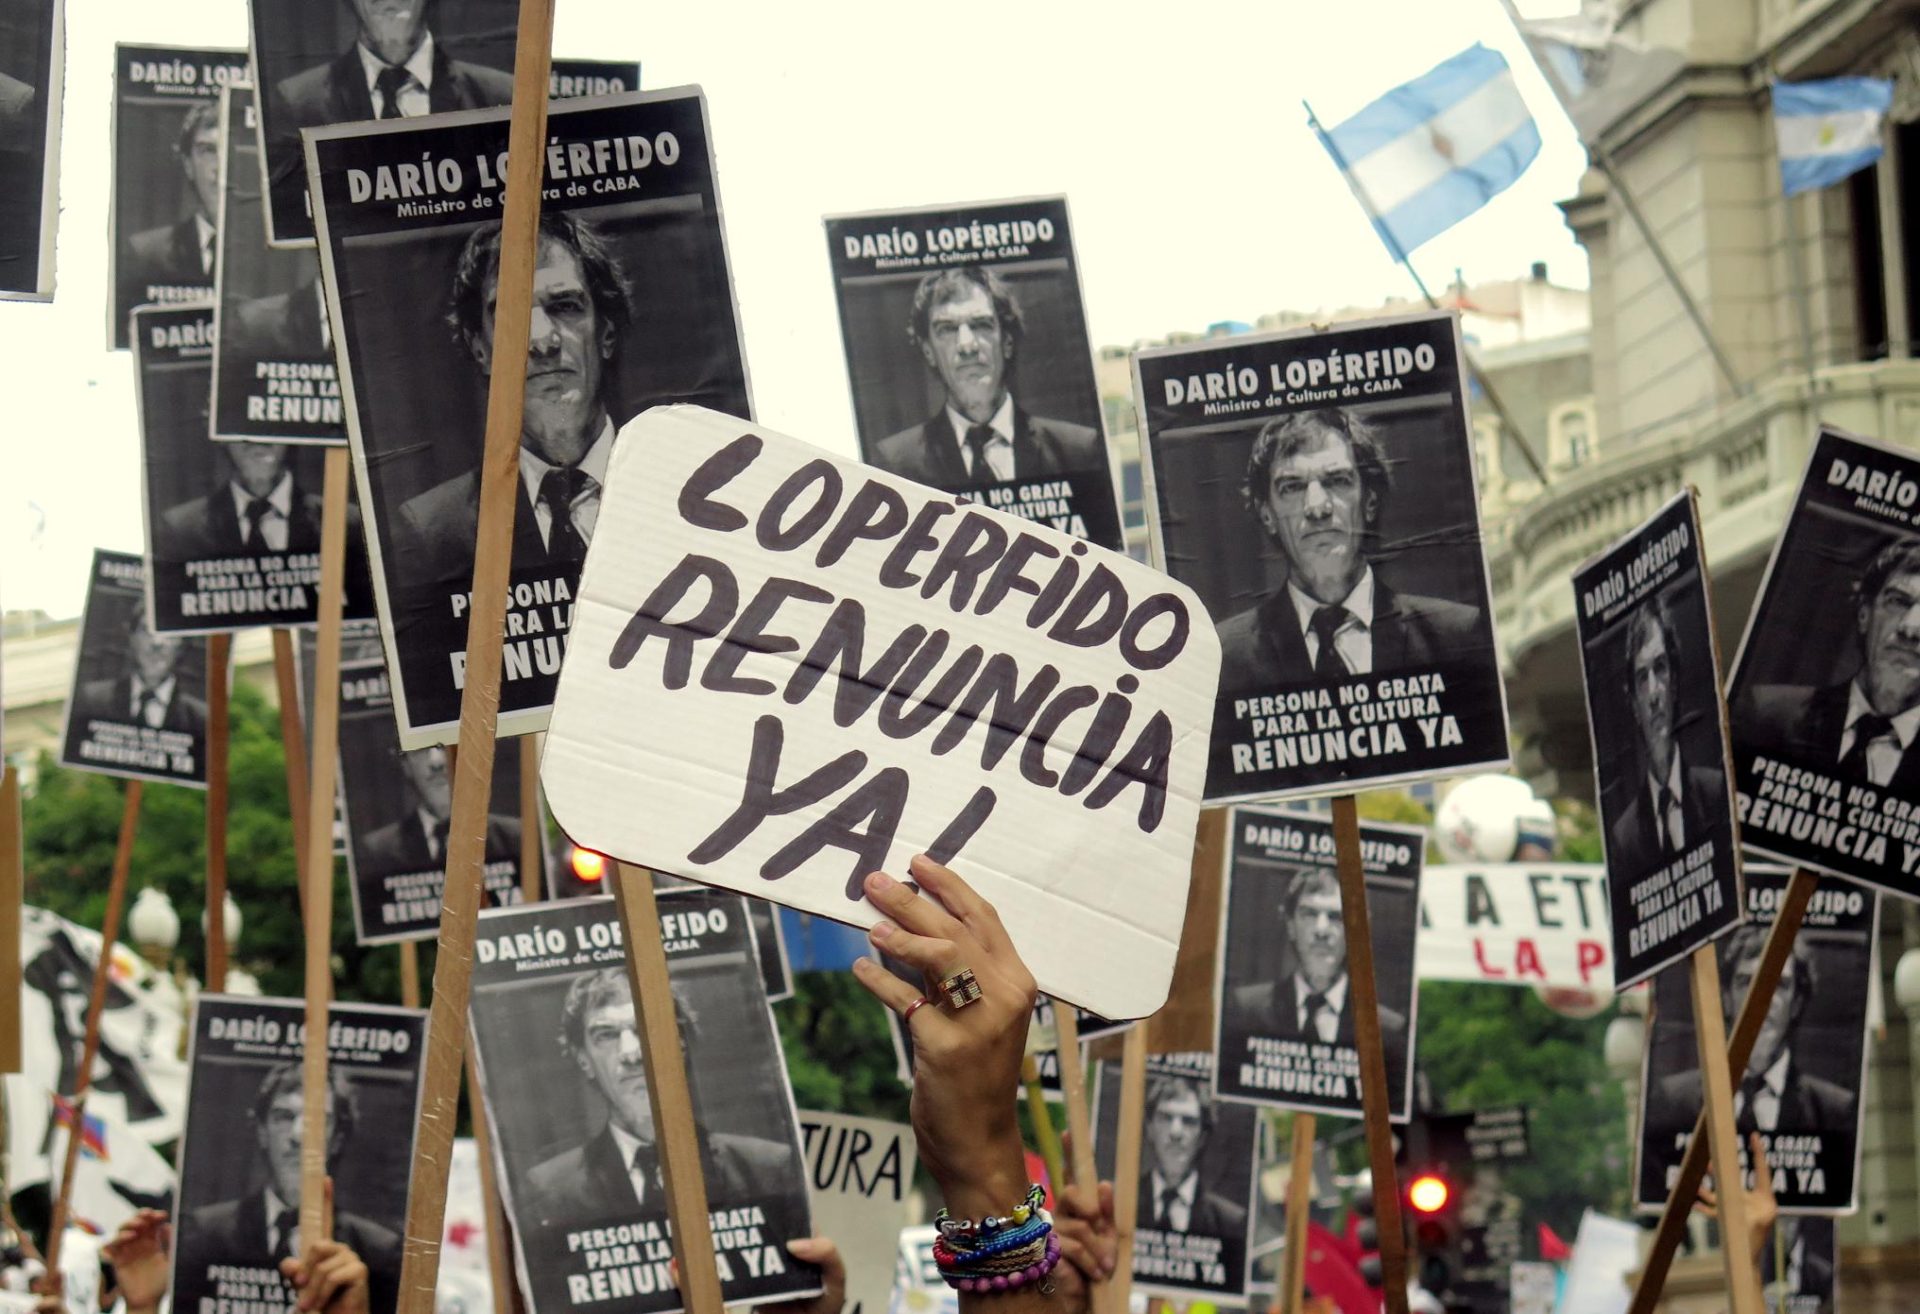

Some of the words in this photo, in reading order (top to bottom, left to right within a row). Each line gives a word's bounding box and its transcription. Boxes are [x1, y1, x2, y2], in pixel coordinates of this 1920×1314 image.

[129, 58, 197, 84] DARÍO
[347, 152, 463, 203] DARÍO
[476, 132, 680, 189] LÉRFIDO
[397, 200, 466, 218] Ministro
[472, 192, 493, 209] de
[566, 181, 588, 198] de
[593, 175, 641, 194] CABA
[844, 227, 918, 259] DARÍO
[926, 218, 1054, 253] LOPÉRFIDO
[875, 256, 921, 269] Ministro
[922, 253, 938, 265] de
[939, 250, 980, 264] Cultura
[982, 247, 997, 259] de
[256, 362, 335, 381] PERSONA
[267, 379, 315, 397] PARA
[319, 380, 340, 397] LA
[1164, 363, 1259, 406] DARÍO
[1270, 343, 1436, 391] LOPÉRFIDO
[248, 395, 341, 424] RENUN
[1204, 398, 1260, 417] Ministro
[1265, 394, 1283, 408] de
[1286, 387, 1338, 405] Cultura
[1342, 383, 1360, 397] de
[1364, 378, 1403, 394] CABA
[989, 487, 1015, 505] NO
[1019, 480, 1074, 499] GRATA
[1826, 458, 1918, 507] DARÍO
[1051, 514, 1089, 539] YA
[1854, 496, 1909, 522] Ministro
[185, 557, 258, 577] PERSONA
[260, 555, 285, 571] NO
[197, 573, 240, 591] PARA
[242, 572, 263, 588] LA
[1584, 569, 1625, 618] DARÍO
[1626, 522, 1689, 588] LOPÉRFIDO
[180, 585, 308, 617] RENUNCIA
[450, 577, 571, 618] PSONA
[503, 609, 544, 638] RA
[449, 634, 569, 690] RNU
[608, 553, 1173, 834] RENUNCIA
[1234, 688, 1333, 719] PERSONA
[1339, 683, 1370, 705] NO
[1377, 673, 1446, 698] GRATA
[1252, 713, 1310, 739] PARA
[1316, 711, 1343, 730] LA
[1349, 695, 1442, 724] CULTURA
[1231, 722, 1407, 774] RENUNCIA
[1417, 715, 1464, 749] YA
[1751, 756, 1842, 800] PERSONA
[1847, 785, 1878, 809] NO
[1758, 779, 1812, 811] PARA
[1816, 797, 1842, 821] LA
[1848, 806, 1920, 845] CULTUR
[1245, 824, 1304, 851] DARÍO
[1735, 791, 1888, 867] RENUNCIA
[1901, 843, 1920, 879] Y
[1465, 874, 1501, 927] A
[1527, 874, 1611, 929] ET
[1629, 893, 1701, 958] RENUNCIA
[1703, 879, 1723, 915] YA
[476, 926, 566, 963] DARÍO
[575, 908, 728, 950] LOPFIDO
[516, 956, 570, 972] Ministro
[573, 953, 592, 965] de
[664, 938, 700, 953] CABA
[1473, 937, 1547, 980] LA
[209, 1015, 281, 1043] DARÍO
[286, 1020, 410, 1053] LÉRFIDO
[1240, 1063, 1348, 1099] RENUNCIA
[1796, 1167, 1826, 1195] YA
[567, 1221, 661, 1252] PERSONA
[585, 1246, 643, 1270] PARA
[646, 1239, 672, 1260] LA
[207, 1264, 280, 1285] PERSONA
[217, 1281, 260, 1299] PARA
[263, 1284, 285, 1302] LA
[567, 1252, 735, 1304] RENUNA
[740, 1245, 785, 1278] YA
[1201, 1261, 1226, 1285] YA
